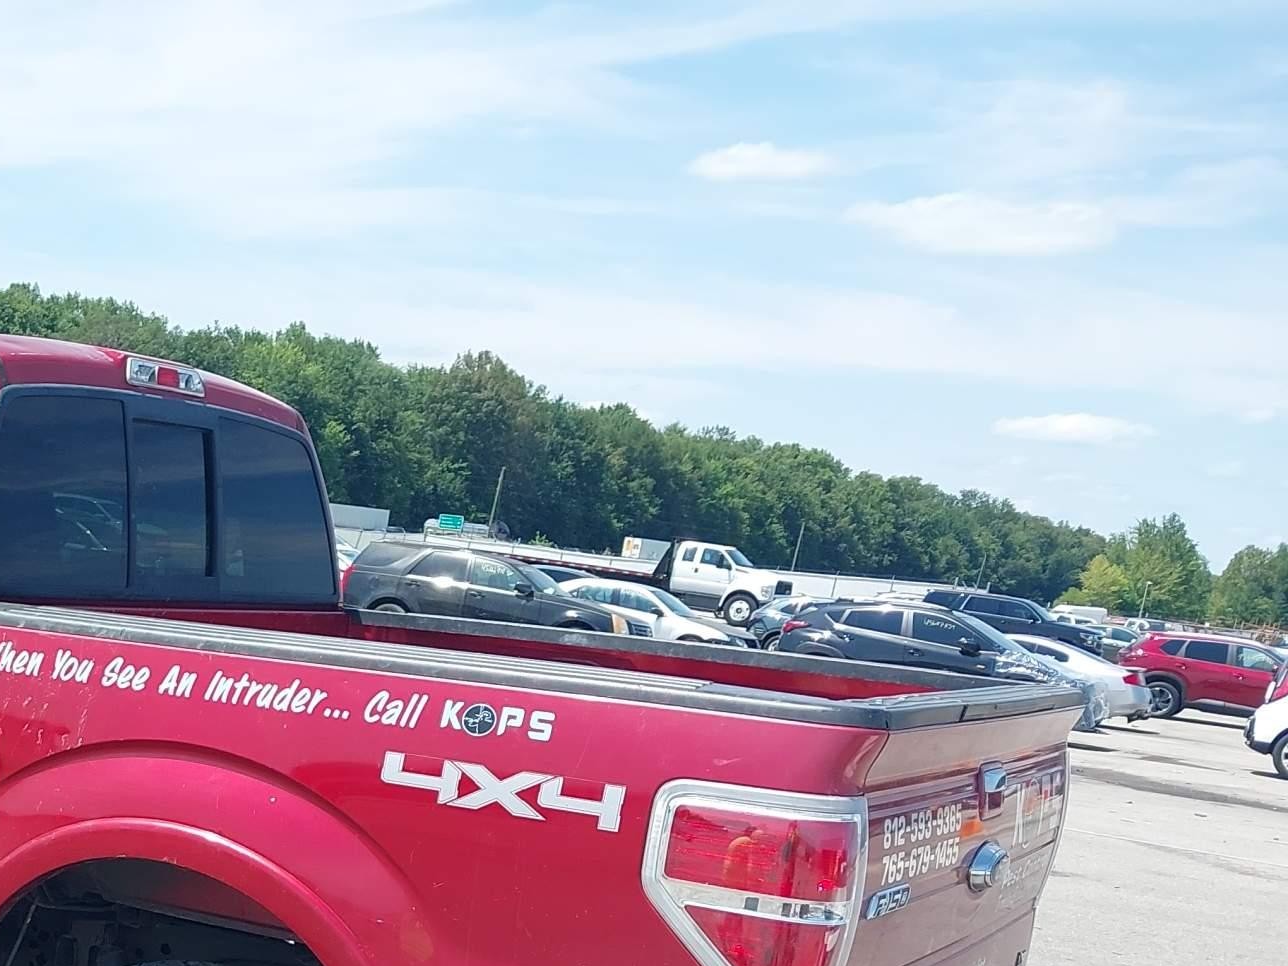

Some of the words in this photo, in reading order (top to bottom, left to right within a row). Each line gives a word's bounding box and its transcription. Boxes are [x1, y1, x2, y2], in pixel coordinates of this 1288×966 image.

[52, 649, 95, 684] You
[101, 656, 151, 691] See
[158, 664, 197, 698] An
[204, 670, 350, 720] Intruder...
[364, 690, 429, 729] Call
[440, 699, 556, 742] KOPS
[883, 804, 962, 850] 812-593-9365
[881, 836, 961, 886] 765-679-1455
